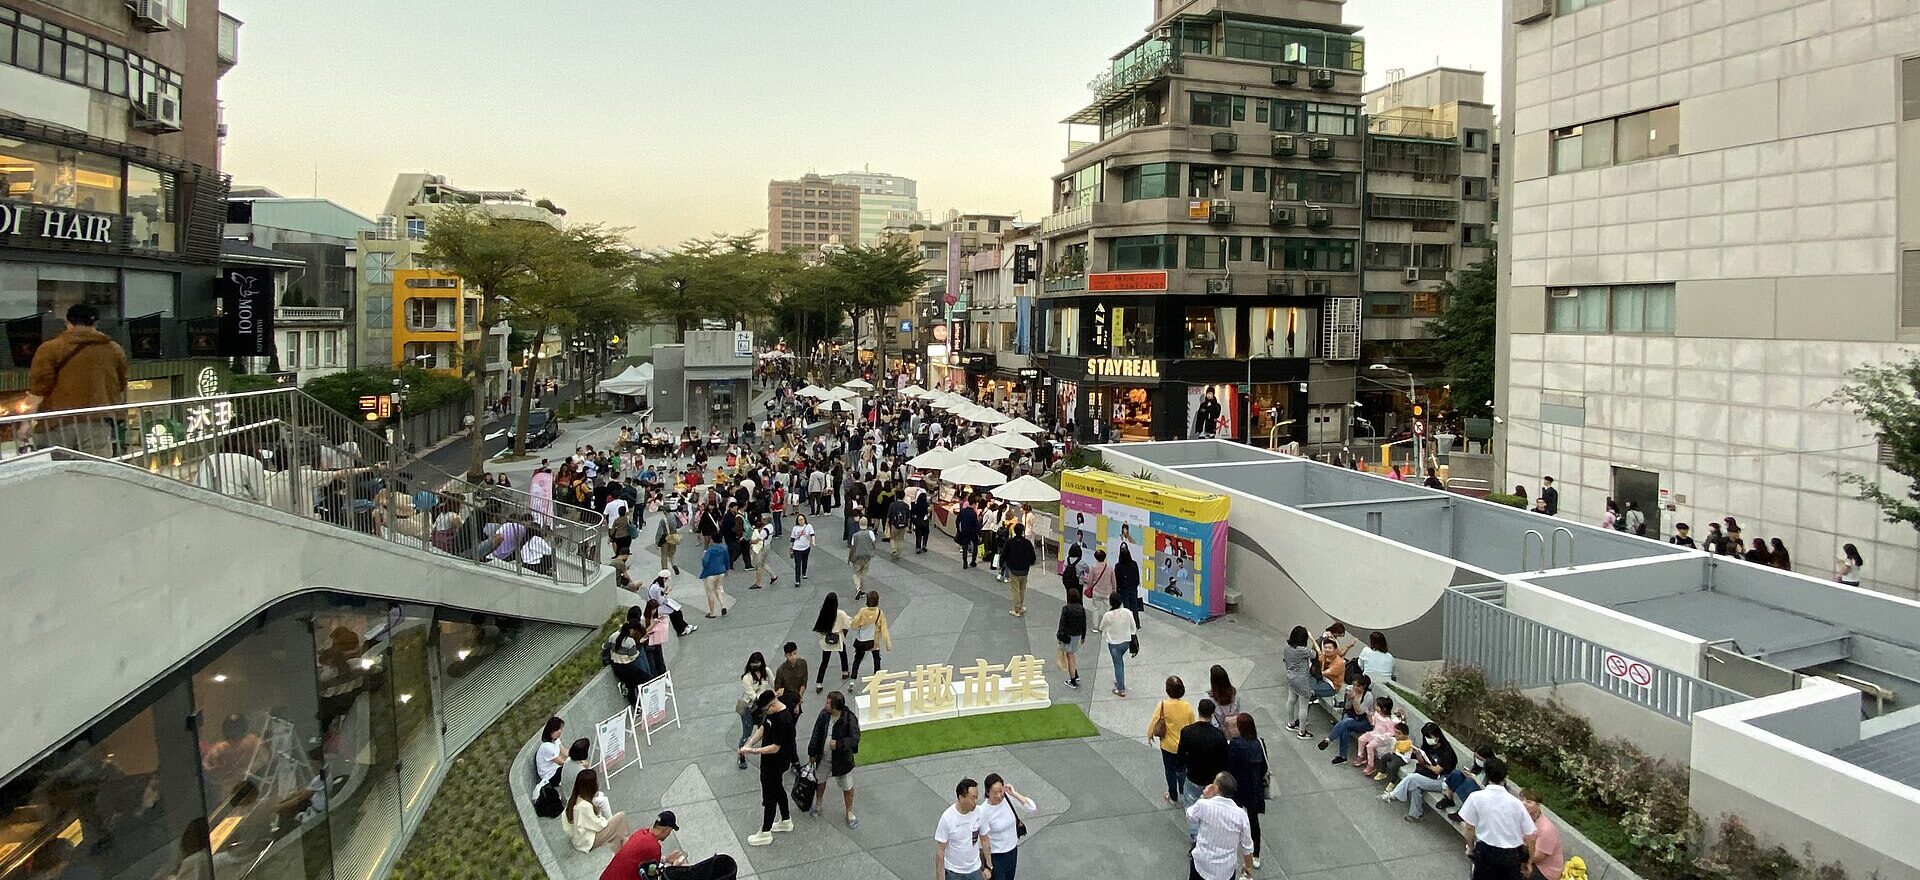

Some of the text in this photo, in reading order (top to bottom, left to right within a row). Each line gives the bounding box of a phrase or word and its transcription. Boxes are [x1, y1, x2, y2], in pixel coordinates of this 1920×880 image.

[40, 208, 112, 244] HAIR
[239, 299, 252, 334] MOOI
[1087, 358, 1160, 377] STAYREAL
[861, 654, 1047, 722] 有趣市集
